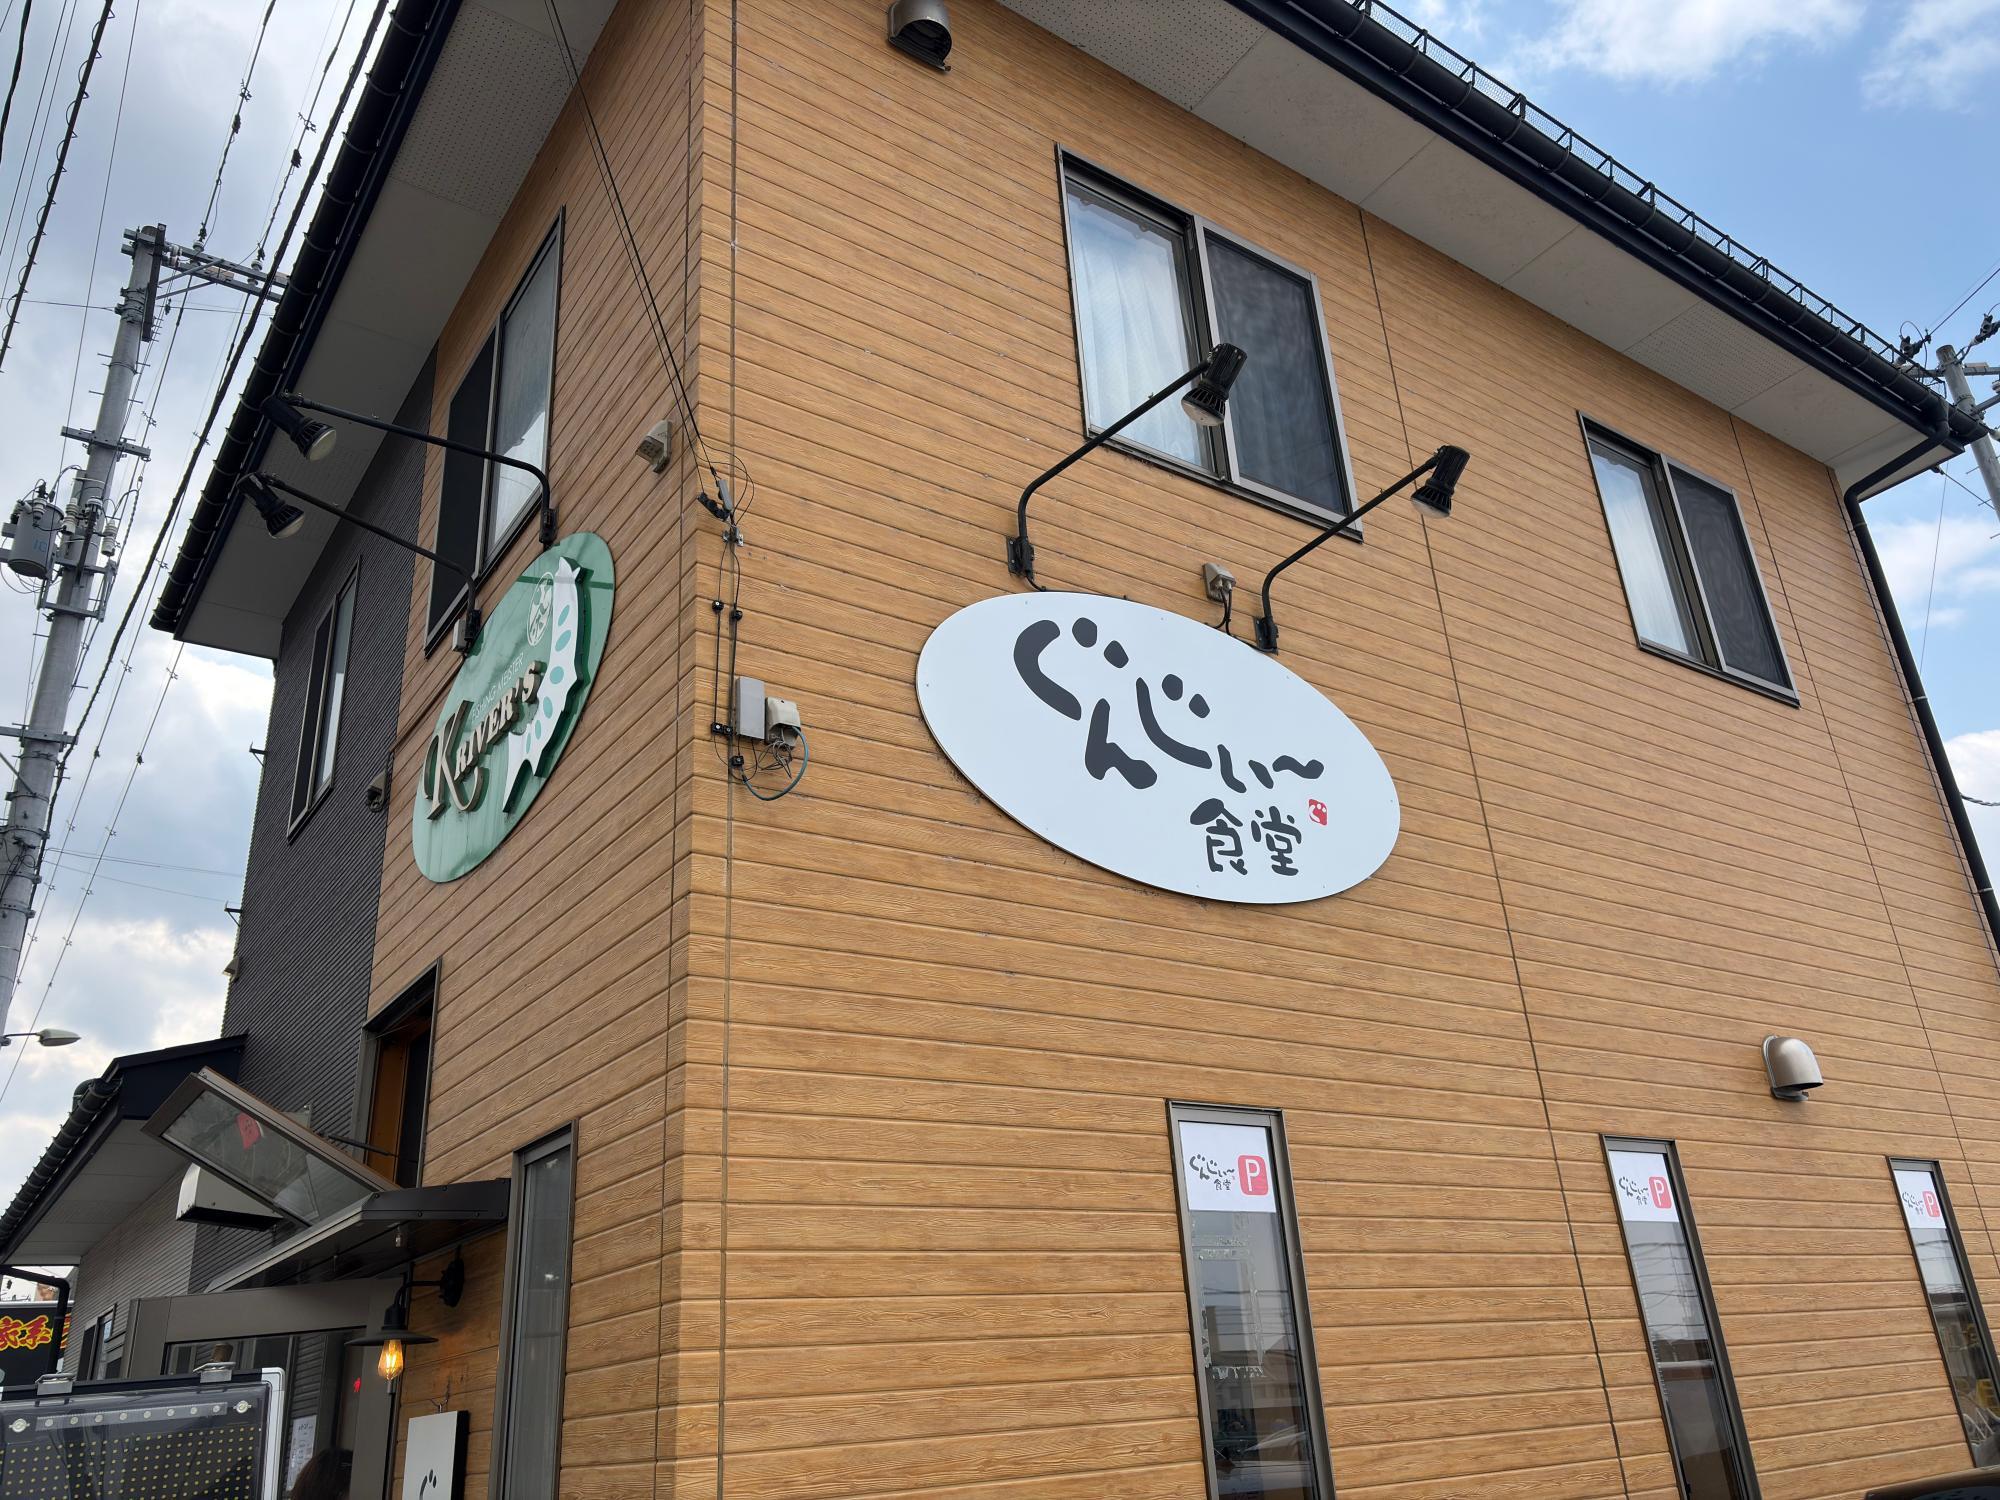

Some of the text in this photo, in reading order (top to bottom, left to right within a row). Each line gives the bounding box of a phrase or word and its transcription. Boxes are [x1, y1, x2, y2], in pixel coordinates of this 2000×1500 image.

[1190, 798, 1301, 876] 食堂
[1245, 1159, 1260, 1191] P
[1653, 1179, 1665, 1207] P
